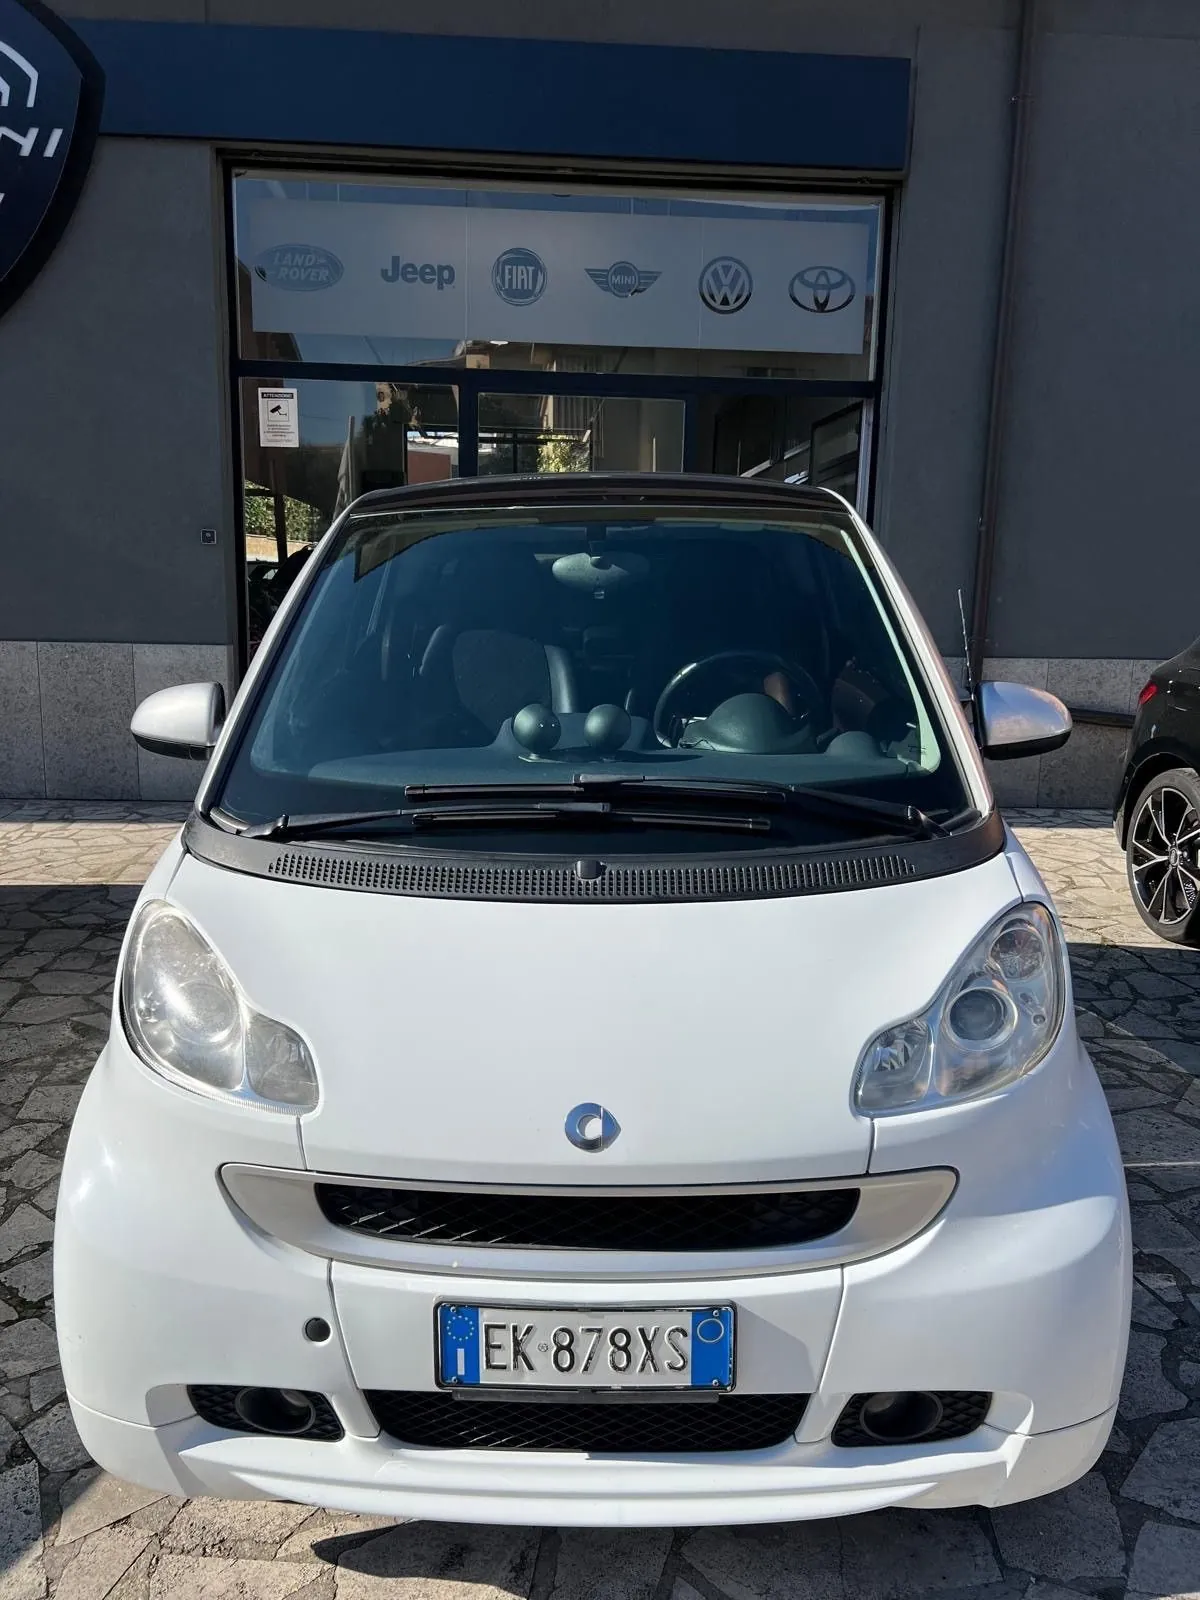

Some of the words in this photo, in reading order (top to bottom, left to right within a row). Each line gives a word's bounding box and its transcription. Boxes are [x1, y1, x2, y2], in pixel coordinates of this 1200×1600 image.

[274, 252, 317, 267] LAND
[277, 266, 330, 282] ROVER
[380, 256, 455, 290] Jeep
[504, 264, 536, 290] FIAT
[611, 275, 636, 285] MINI
[484, 1322, 535, 1371] EK
[550, 1325, 689, 1374] 878XS
